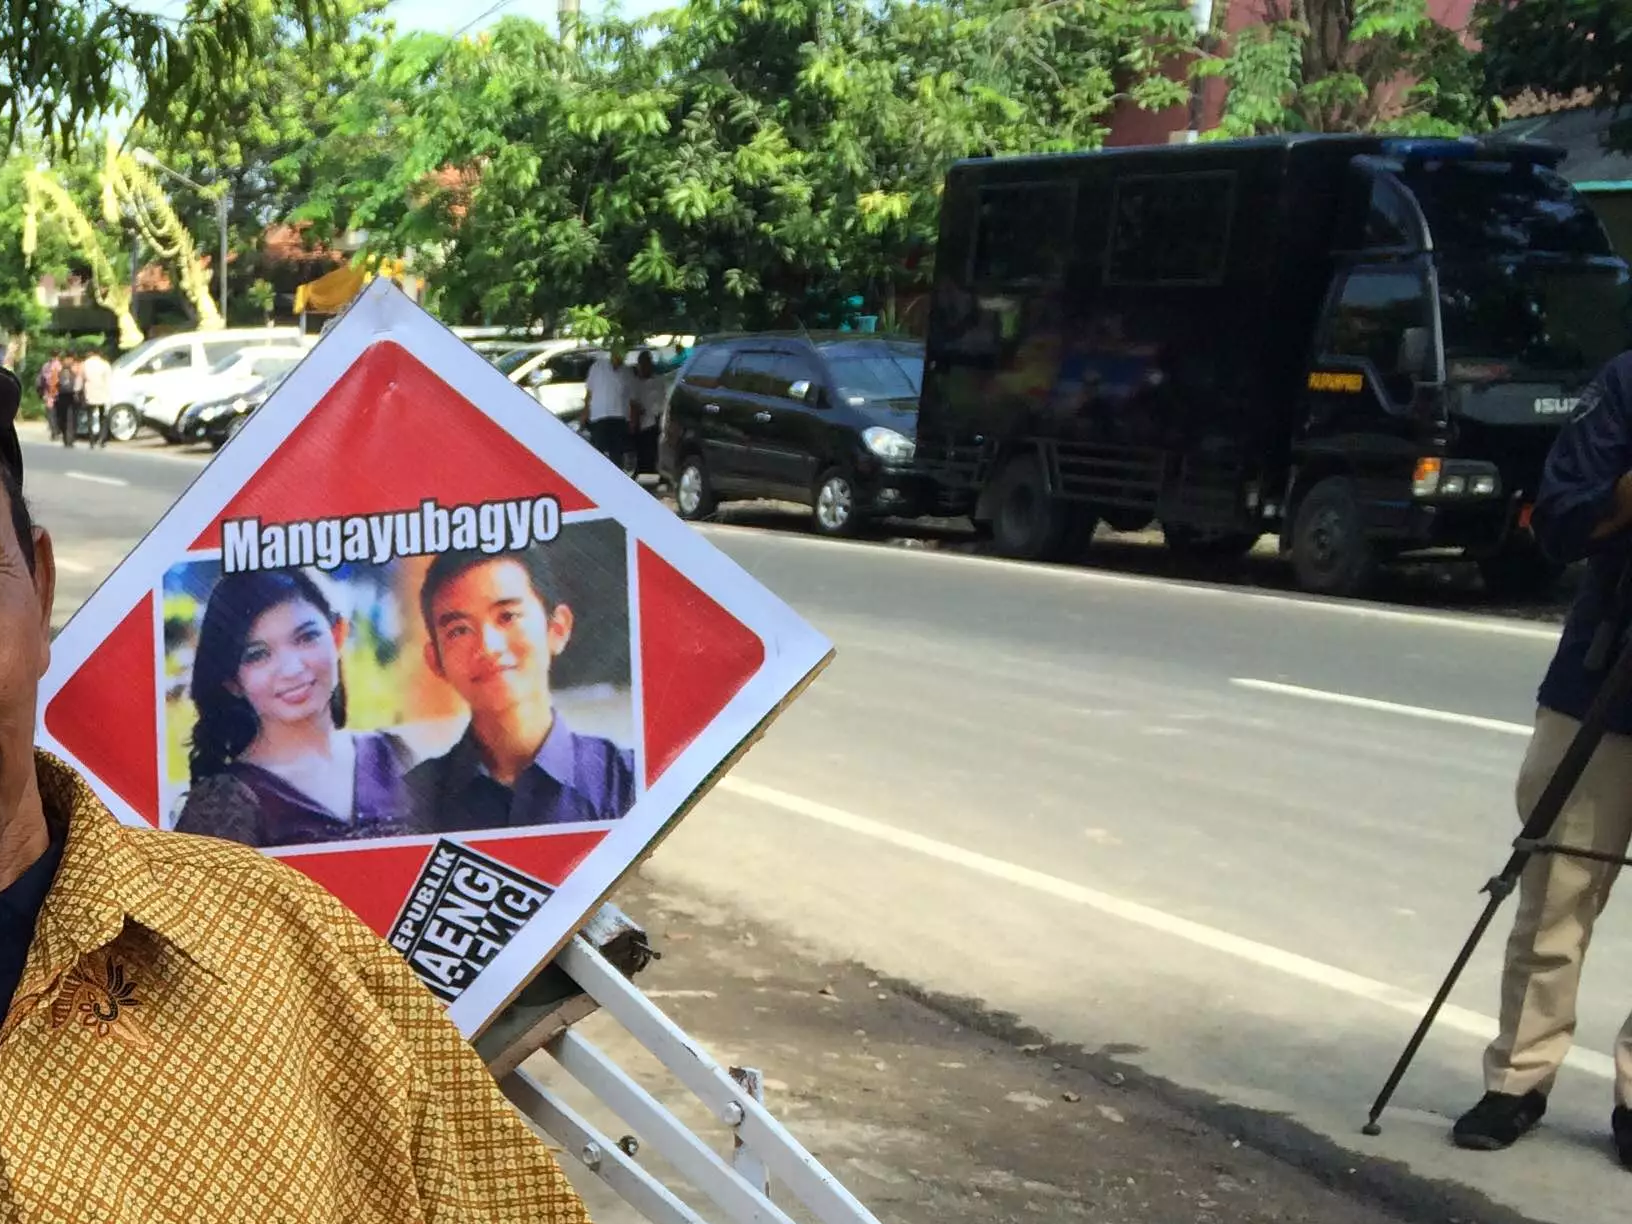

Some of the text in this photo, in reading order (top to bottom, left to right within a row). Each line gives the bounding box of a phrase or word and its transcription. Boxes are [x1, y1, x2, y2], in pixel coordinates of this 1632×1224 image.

[1534, 398, 1581, 414] ISUZ
[222, 496, 561, 573] Mangayubagyo
[392, 848, 458, 951] EPUBLIK
[413, 867, 501, 984] AENG
